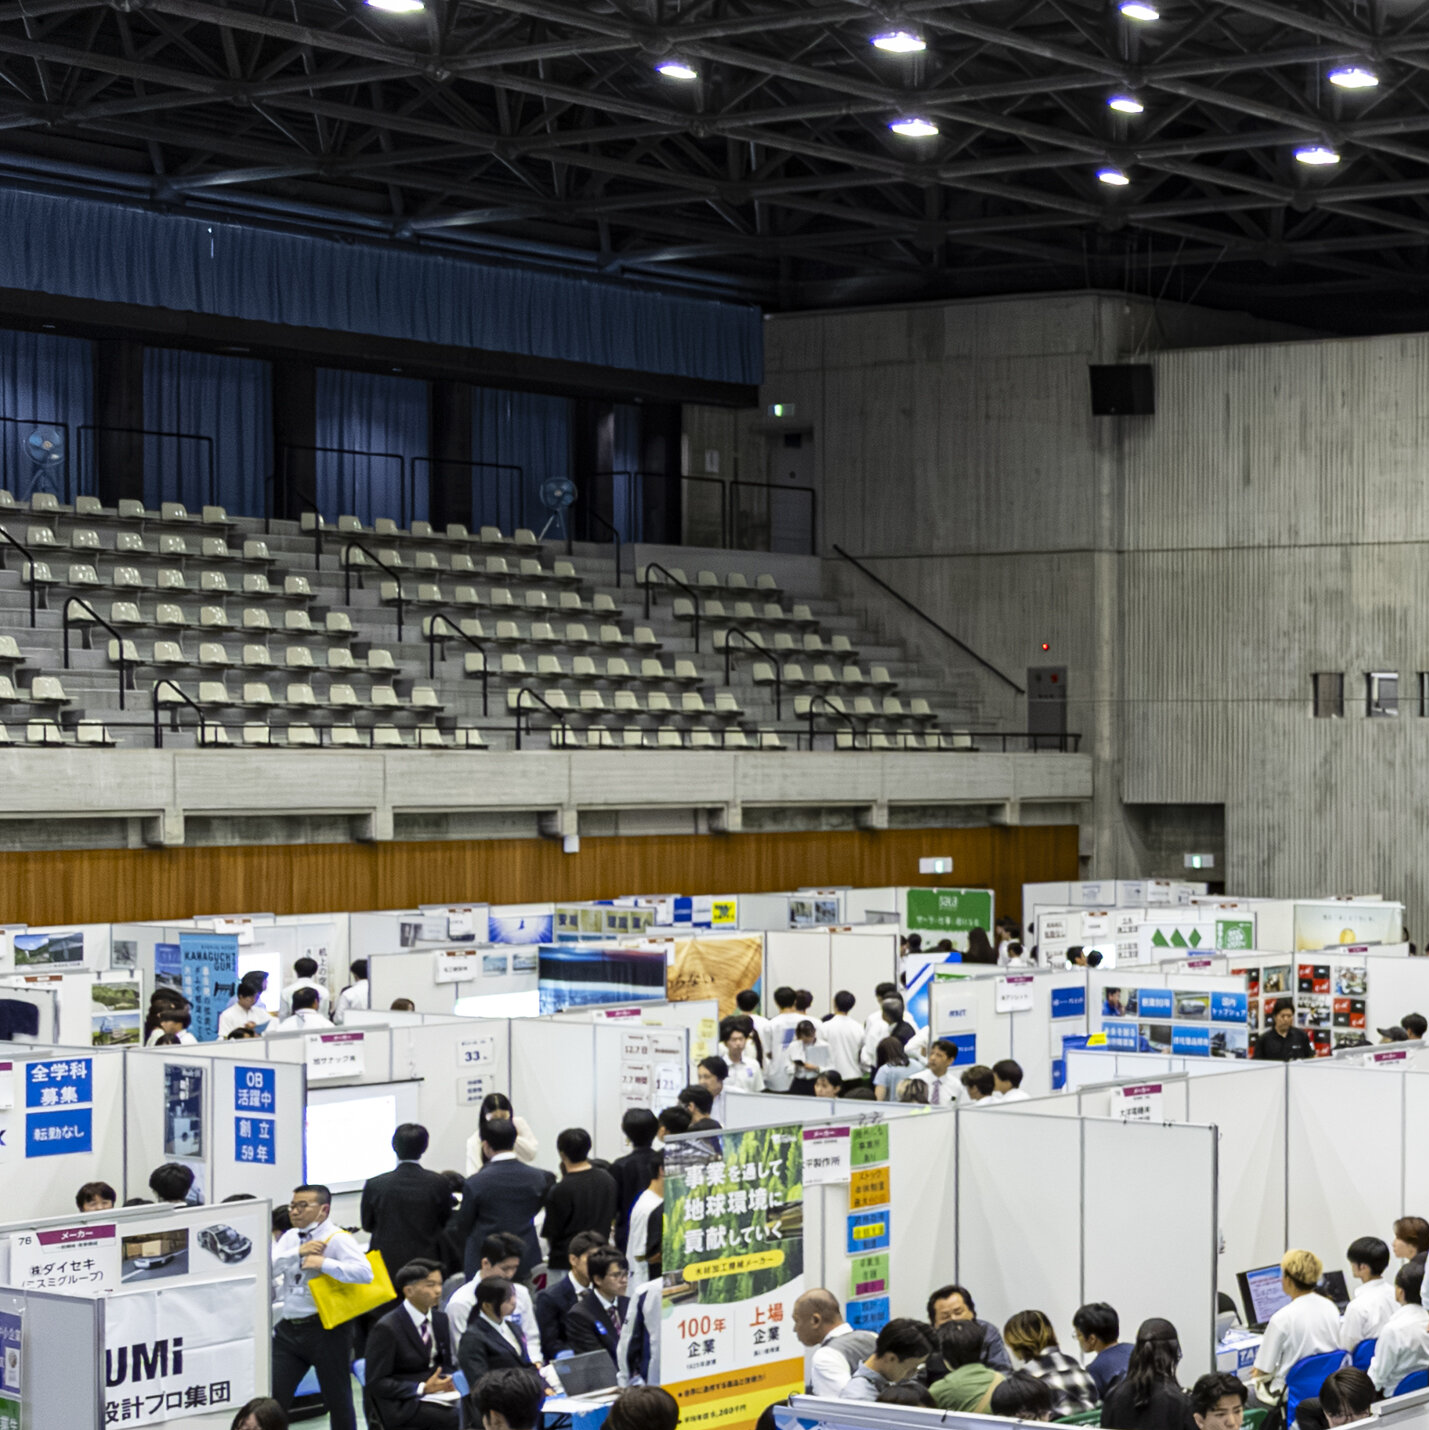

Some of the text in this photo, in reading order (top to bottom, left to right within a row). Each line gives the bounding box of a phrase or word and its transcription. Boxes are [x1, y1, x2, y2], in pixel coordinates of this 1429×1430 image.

[31, 1059, 88, 1082] 全学科
[246, 1072, 263, 1088] OB
[40, 1086, 78, 1105] 募集
[33, 1124, 85, 1141] 転勤なし
[61, 1229, 93, 1241] メーカー
[684, 1222, 782, 1254] 貢献していく
[750, 1302, 784, 1328] 上場
[678, 1316, 726, 1339] 100年
[754, 1326, 779, 1346] 企業
[688, 1339, 716, 1358] 企業
